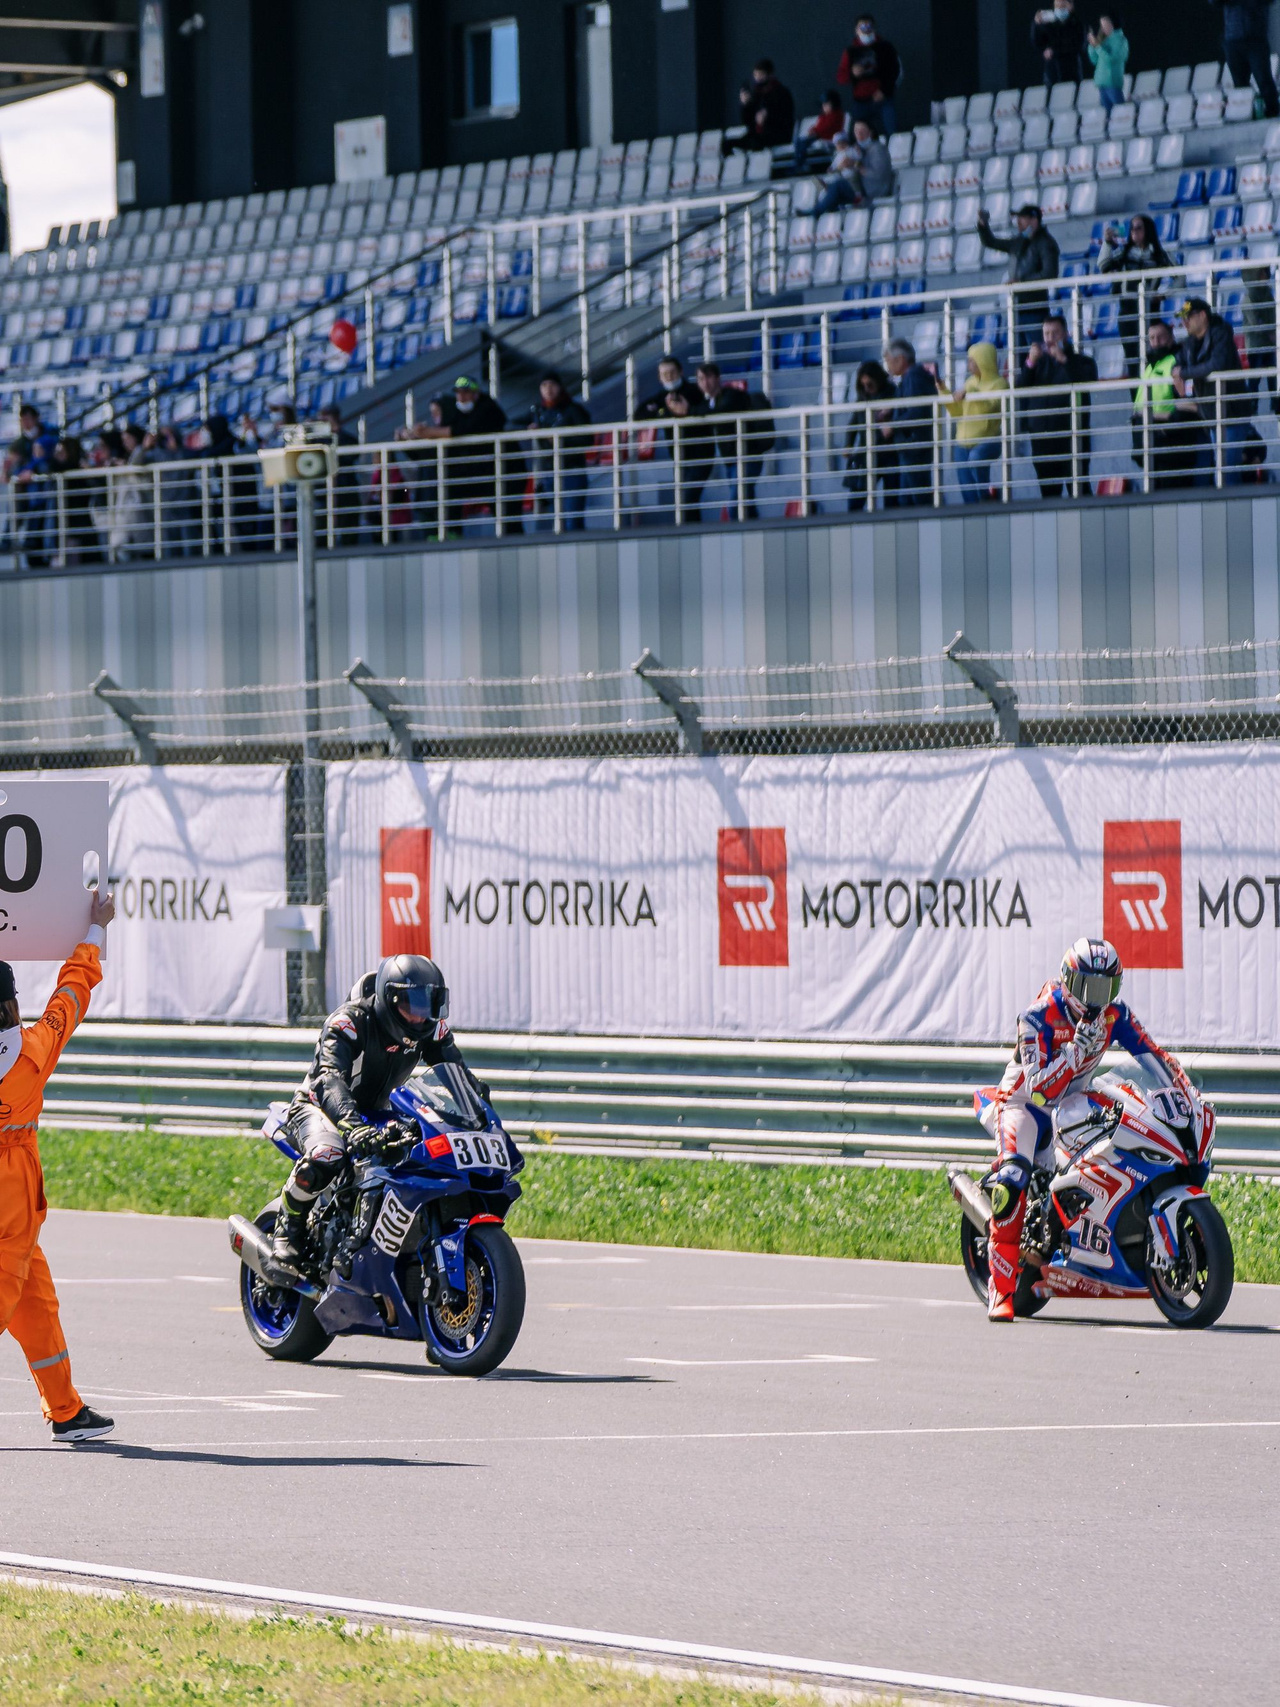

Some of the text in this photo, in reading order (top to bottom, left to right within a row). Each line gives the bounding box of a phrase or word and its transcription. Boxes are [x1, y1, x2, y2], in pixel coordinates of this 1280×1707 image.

[444, 878, 657, 927] MOTORRIKA
[802, 877, 1032, 929] MOTORRIKA
[1154, 1091, 1189, 1120] 16
[453, 1136, 508, 1167] 303
[375, 1197, 411, 1253] 303
[1080, 1214, 1111, 1255] 16
